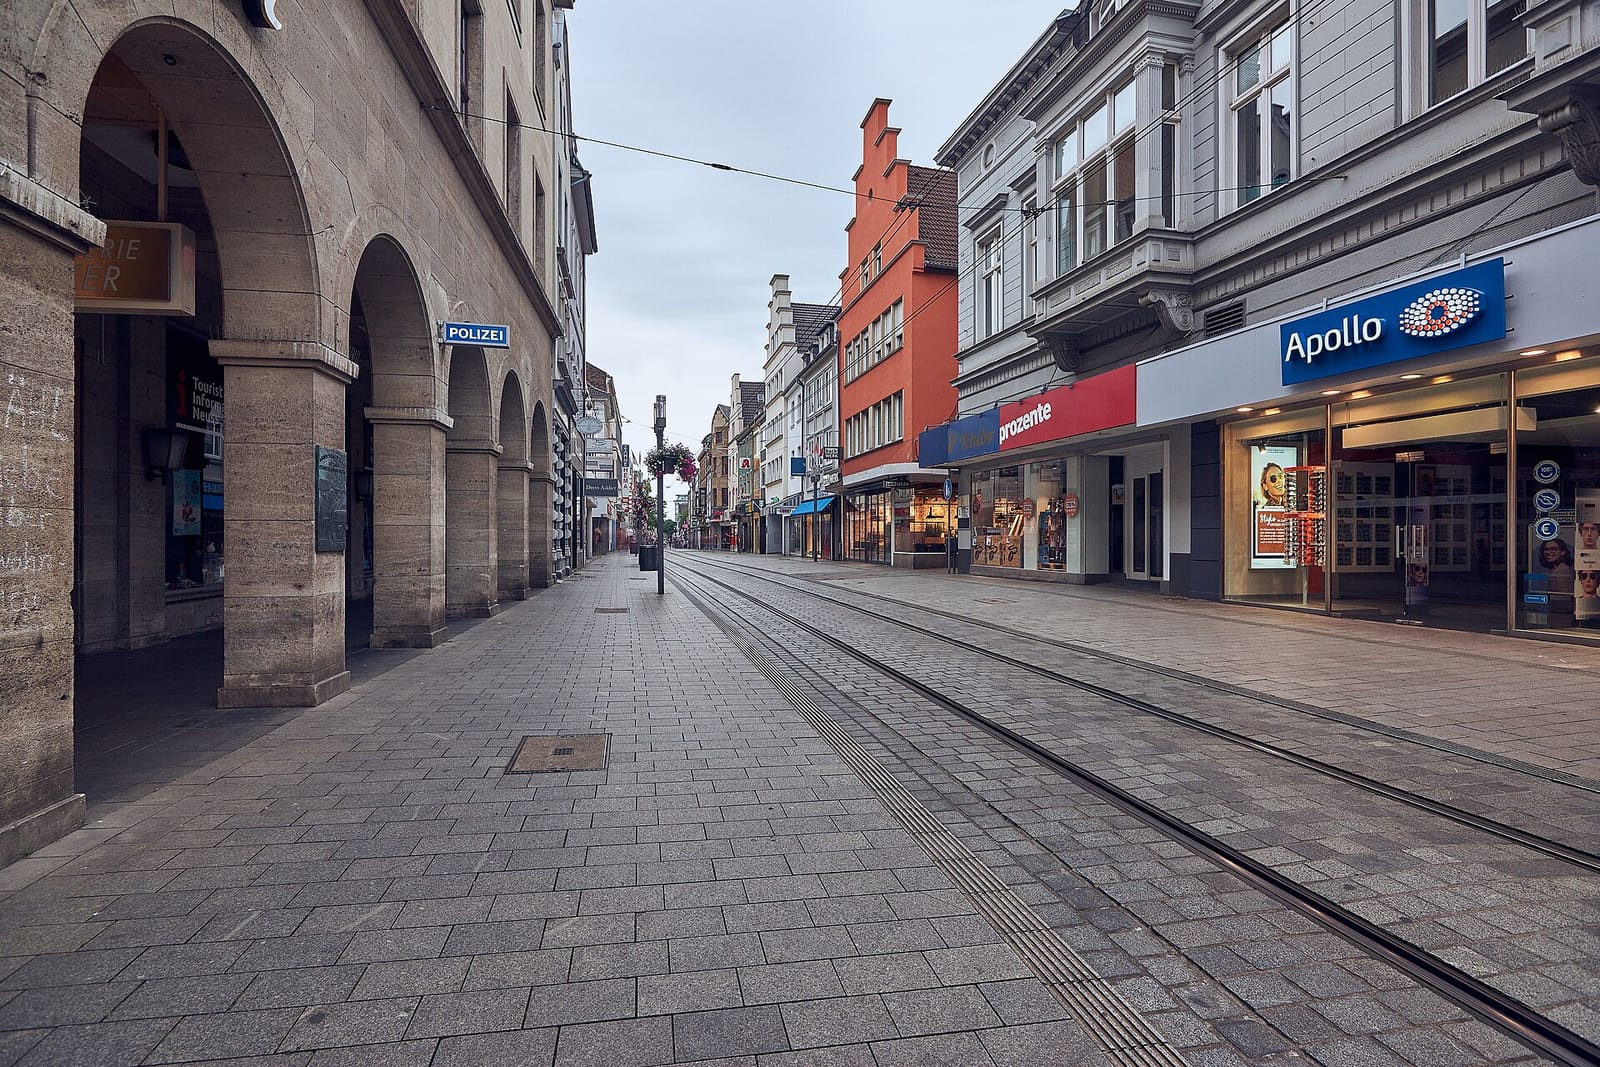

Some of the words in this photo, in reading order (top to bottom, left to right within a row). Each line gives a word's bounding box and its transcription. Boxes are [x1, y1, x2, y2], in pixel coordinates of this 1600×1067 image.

[88, 239, 141, 260] RIE
[449, 327, 504, 341] POLIZEI
[1284, 315, 1383, 364] Apollo
[192, 376, 223, 399] Tourist
[192, 406, 219, 425] Neuss
[999, 402, 1052, 445] prozente
